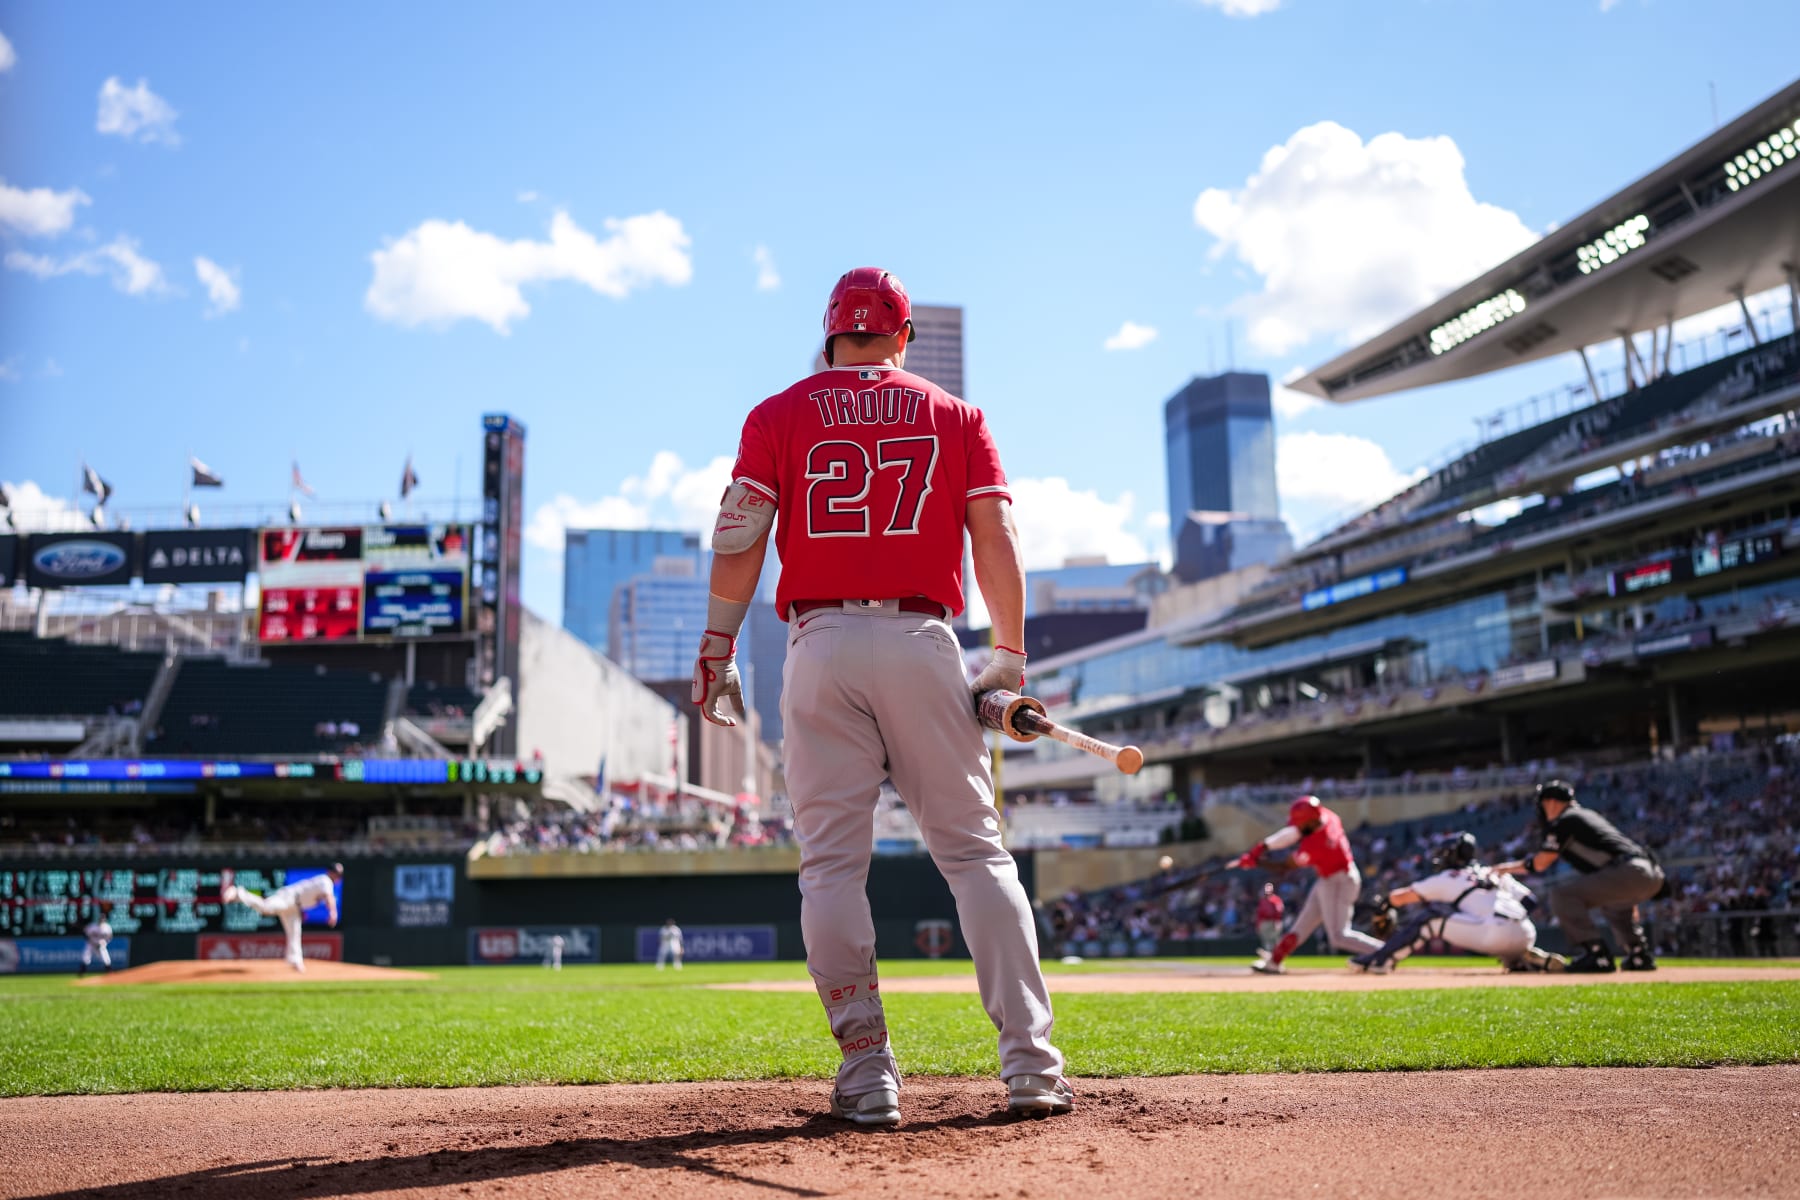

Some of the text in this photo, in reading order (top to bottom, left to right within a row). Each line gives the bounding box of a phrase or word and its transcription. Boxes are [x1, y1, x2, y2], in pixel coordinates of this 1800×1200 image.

[854, 309, 867, 319] 27
[809, 388, 926, 428] TROUT
[804, 435, 939, 538] 27
[748, 495, 766, 508] 27
[51, 549, 106, 572] Ford
[172, 547, 243, 566] DELTA
[829, 984, 857, 1001] 27
